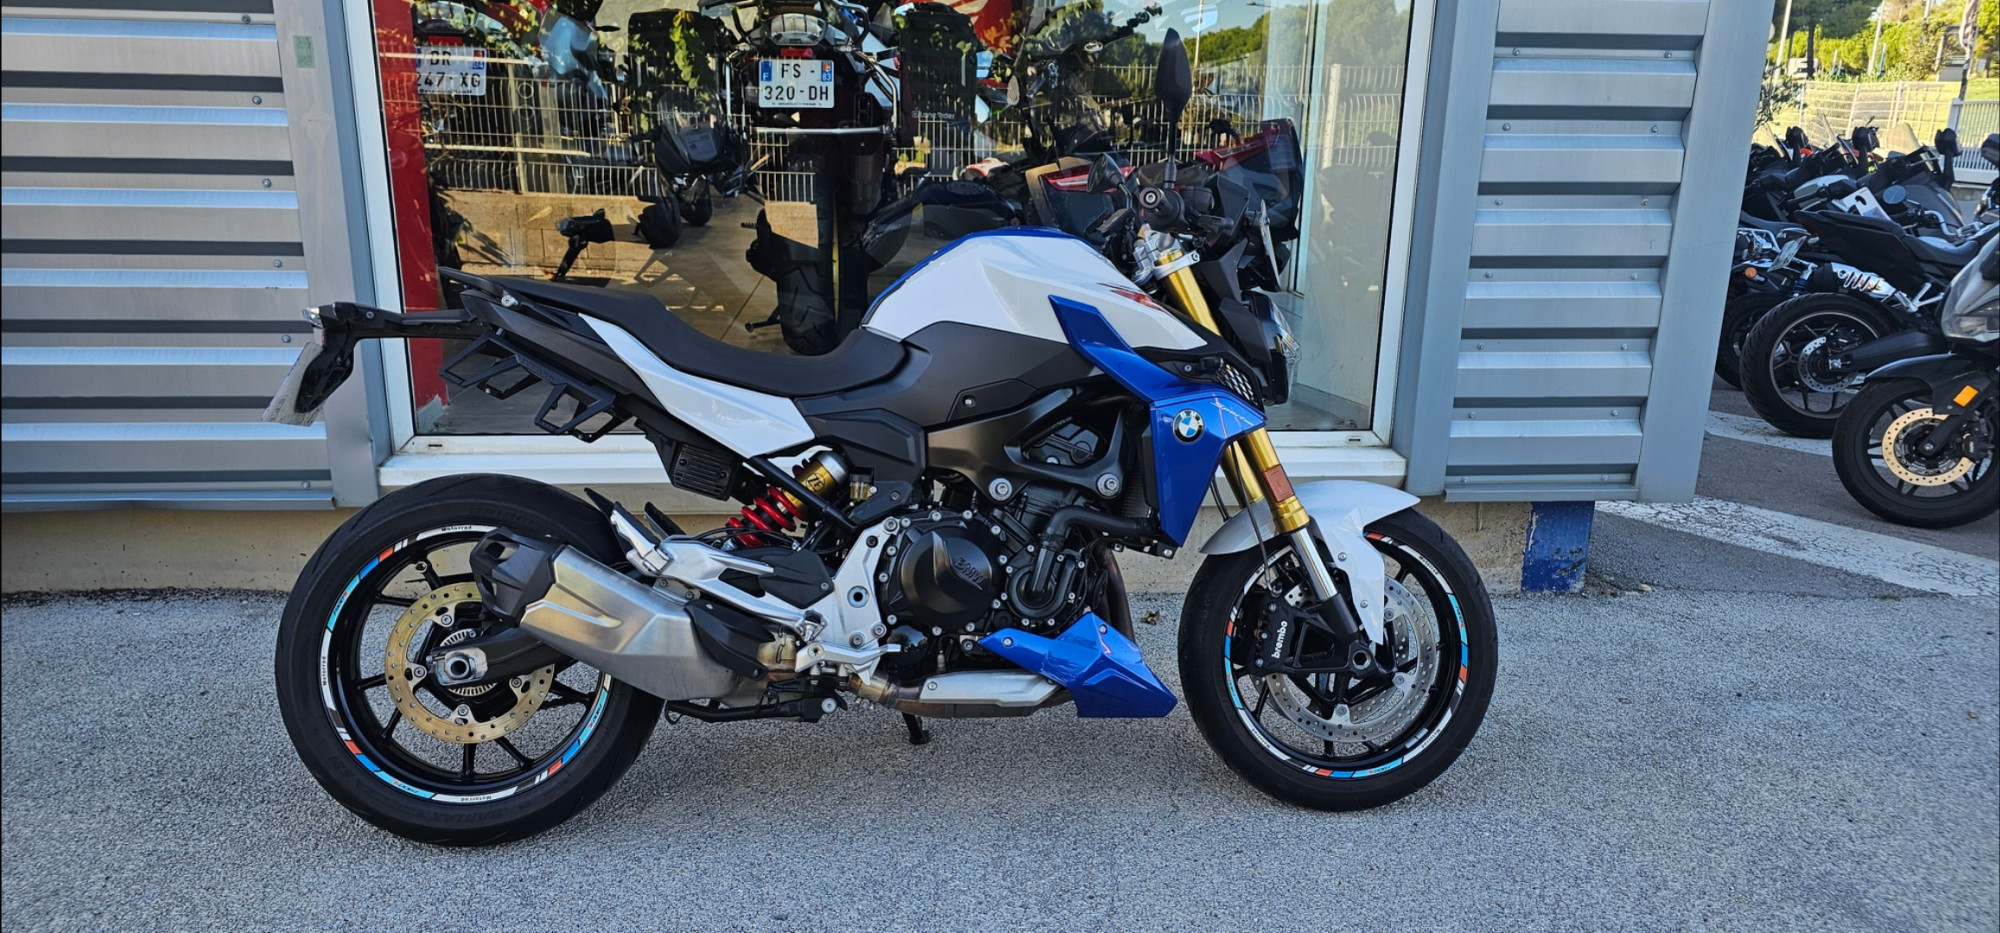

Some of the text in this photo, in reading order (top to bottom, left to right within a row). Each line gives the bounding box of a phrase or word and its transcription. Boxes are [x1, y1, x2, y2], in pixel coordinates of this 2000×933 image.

[763, 72, 769, 80] F
[953, 556, 988, 584] BMW
[1271, 620, 1288, 659] brembo
